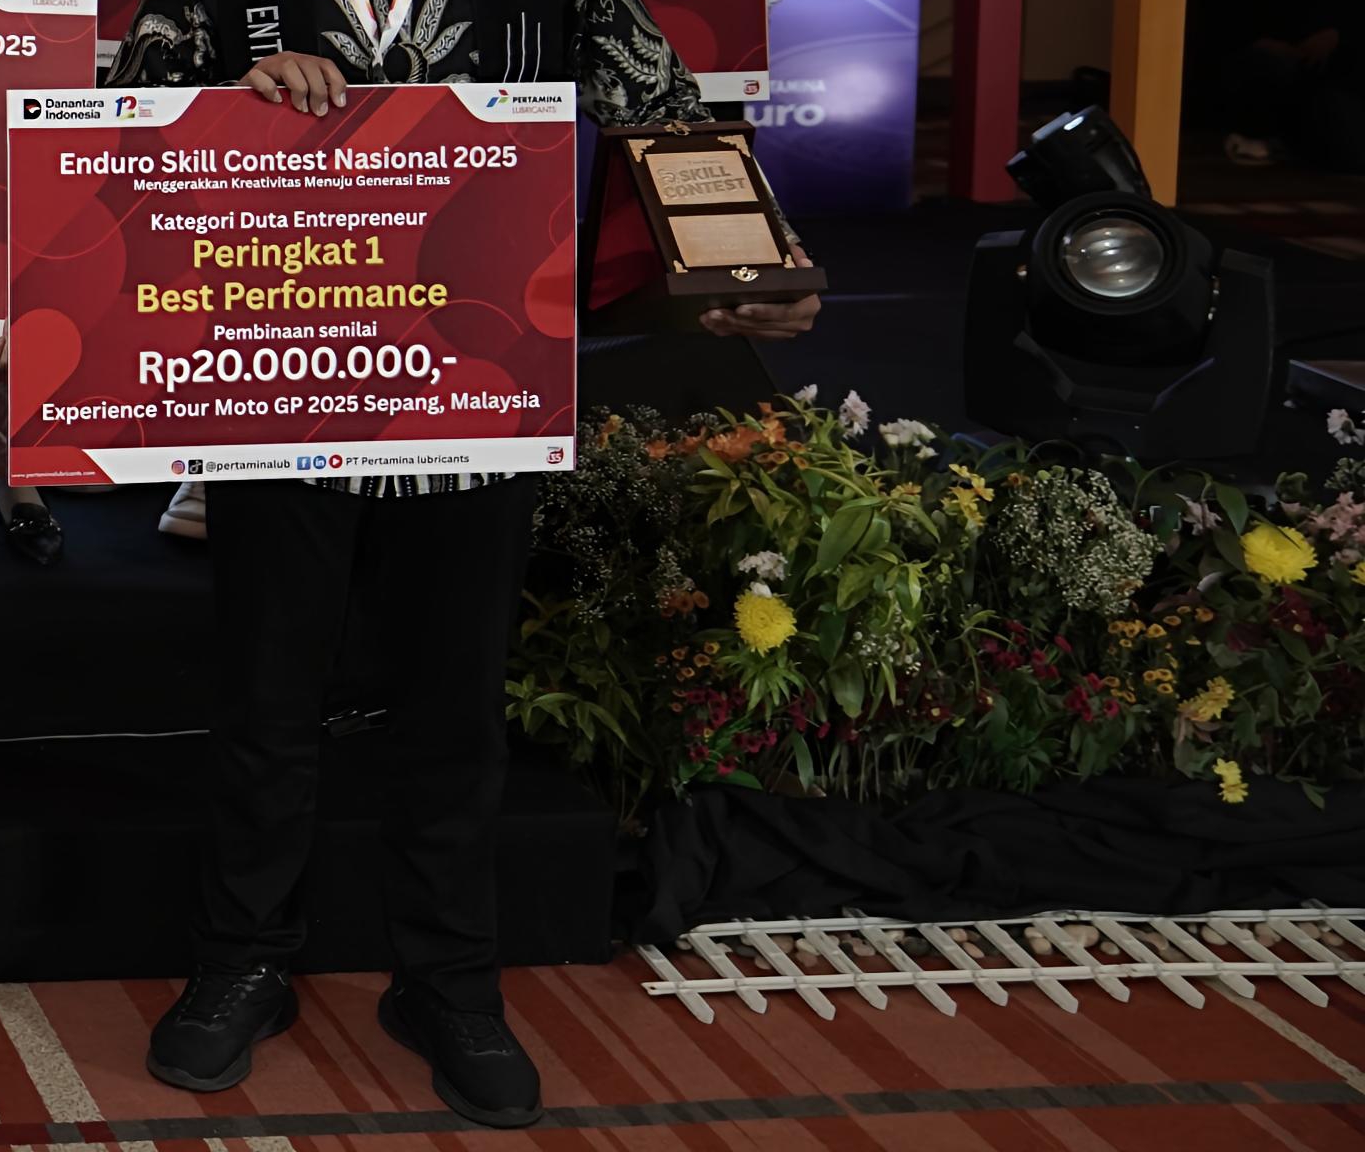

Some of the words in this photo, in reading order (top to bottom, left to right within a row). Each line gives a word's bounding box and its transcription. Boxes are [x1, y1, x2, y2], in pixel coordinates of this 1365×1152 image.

[46, 99, 104, 108] Danantara
[46, 109, 100, 119] Indonesia
[115, 96, 137, 119] 12
[744, 103, 826, 127] uro
[61, 151, 154, 174] Enduro
[162, 150, 216, 173] Skill
[224, 150, 327, 171] Contest
[335, 146, 447, 169] Nasional
[454, 146, 517, 168] 2025
[134, 178, 227, 193] Menggerakkan
[232, 176, 301, 188] Kreativitas
[305, 175, 352, 189] Menuju
[356, 174, 412, 186] Generasi
[417, 175, 450, 185] Emas
[680, 166, 731, 182] SKILL
[664, 178, 745, 198] CONTEST
[152, 212, 234, 234] Kategori
[241, 212, 288, 228] Duta
[294, 211, 427, 230] Entrepreneur
[194, 236, 356, 274] Peringkat
[366, 236, 383, 264] 1
[138, 284, 214, 312] Best
[225, 279, 447, 310] Performance
[215, 324, 314, 340] Pembinaan
[319, 321, 376, 337] senilai
[140, 344, 456, 392] Rp20.000.000,-
[43, 401, 157, 424] Experience
[162, 400, 209, 417] Tour
[215, 399, 268, 415] Moto
[275, 397, 303, 414] GP
[308, 395, 358, 413] 2025
[364, 395, 444, 415] Sepang,
[451, 391, 540, 413] Malaysia
[206, 460, 290, 472] @pertaminalub
[346, 457, 358, 465] PT
[362, 456, 414, 465] Pertamina
[418, 456, 469, 464] lubricants
